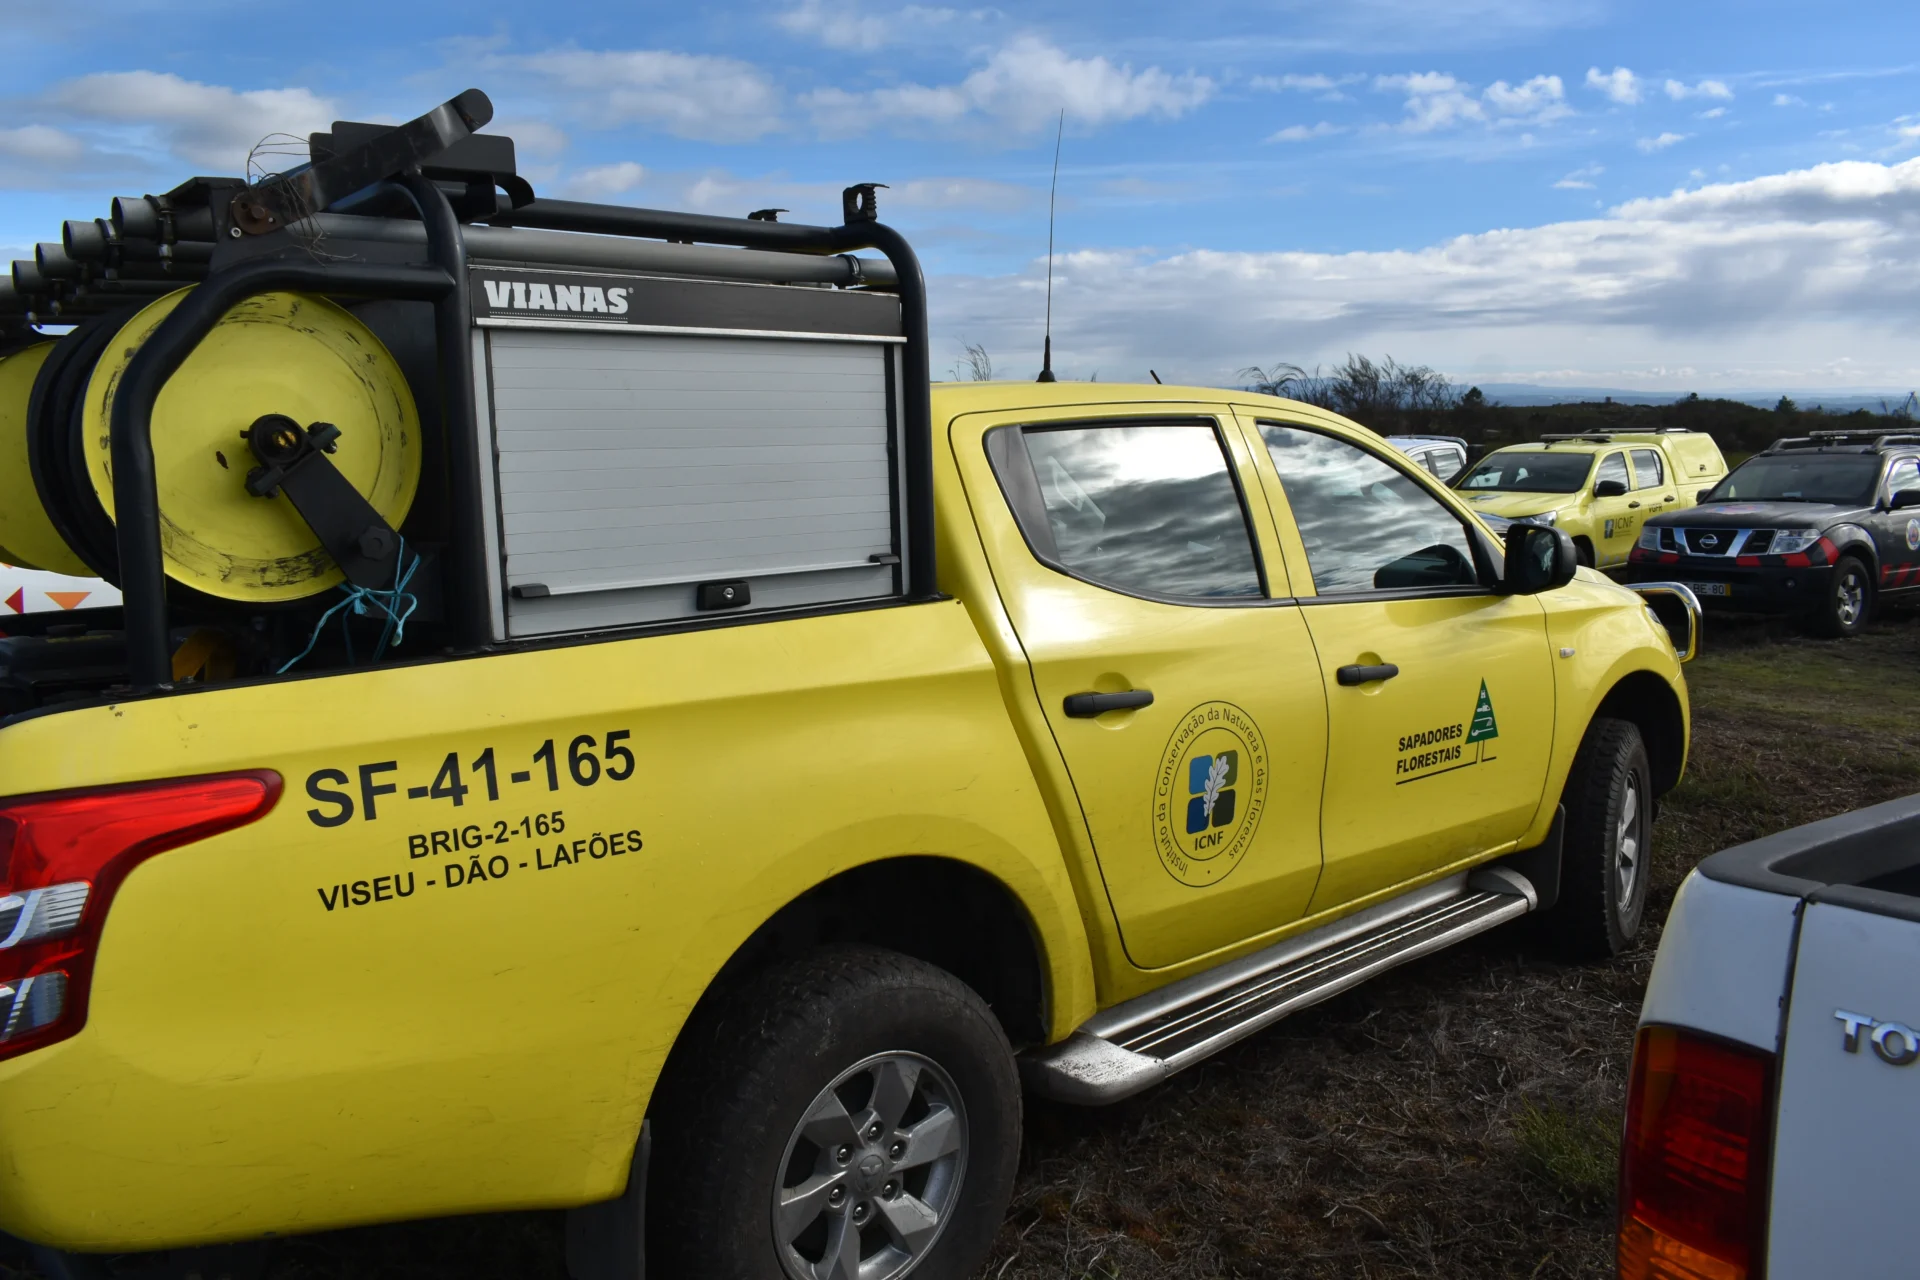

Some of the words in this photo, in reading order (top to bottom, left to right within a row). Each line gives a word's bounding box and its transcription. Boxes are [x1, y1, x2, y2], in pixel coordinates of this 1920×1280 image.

[484, 280, 628, 314] VIANAS
[1615, 516, 1634, 530] ICNF
[1207, 708, 1220, 721] da
[1222, 708, 1260, 753] Natureza
[1398, 723, 1463, 752] SAPADORES
[1158, 712, 1205, 797] Conservação
[1255, 755, 1263, 764] e
[1396, 745, 1462, 775] FLORESTAIS
[305, 729, 636, 828] SF-41-165
[1256, 768, 1266, 794] das
[1156, 802, 1166, 822] da
[408, 810, 566, 859] BRIG-2-165
[1194, 830, 1224, 851] ICNF
[1228, 799, 1262, 859] Florestas
[1160, 825, 1189, 877] Instituto
[317, 872, 416, 912] VISEU
[444, 854, 509, 888] DÃO
[535, 829, 643, 871] LAFÕES
